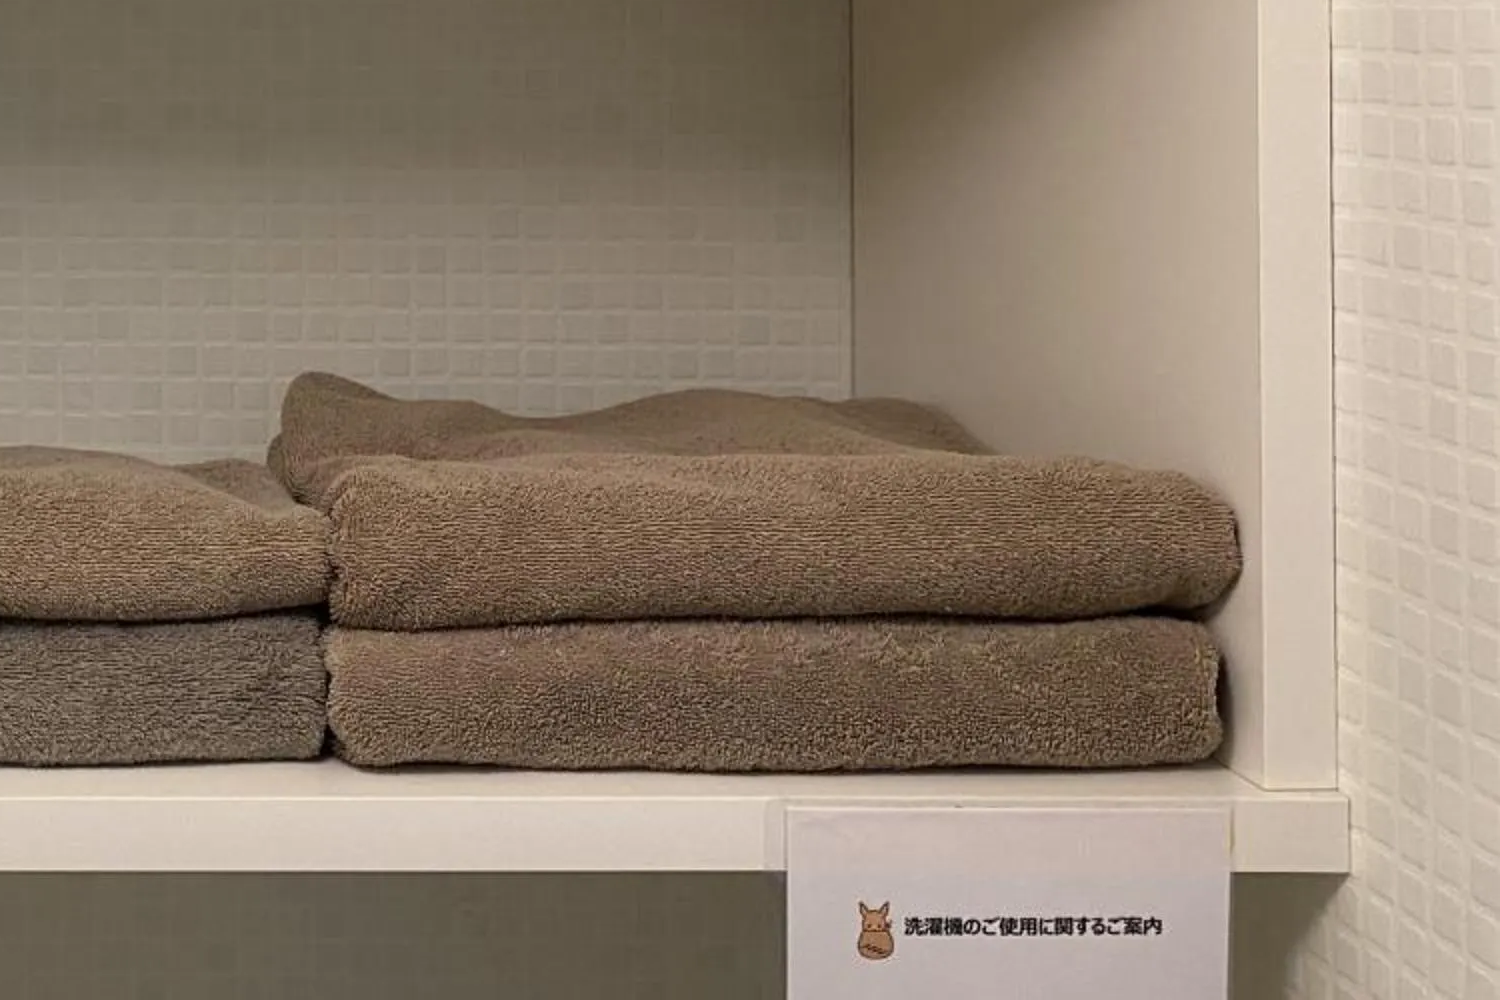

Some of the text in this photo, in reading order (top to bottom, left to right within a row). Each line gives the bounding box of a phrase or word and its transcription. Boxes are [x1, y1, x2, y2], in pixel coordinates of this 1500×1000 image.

[904, 917, 1162, 936] 洗濯機のご使用に関するご案内
